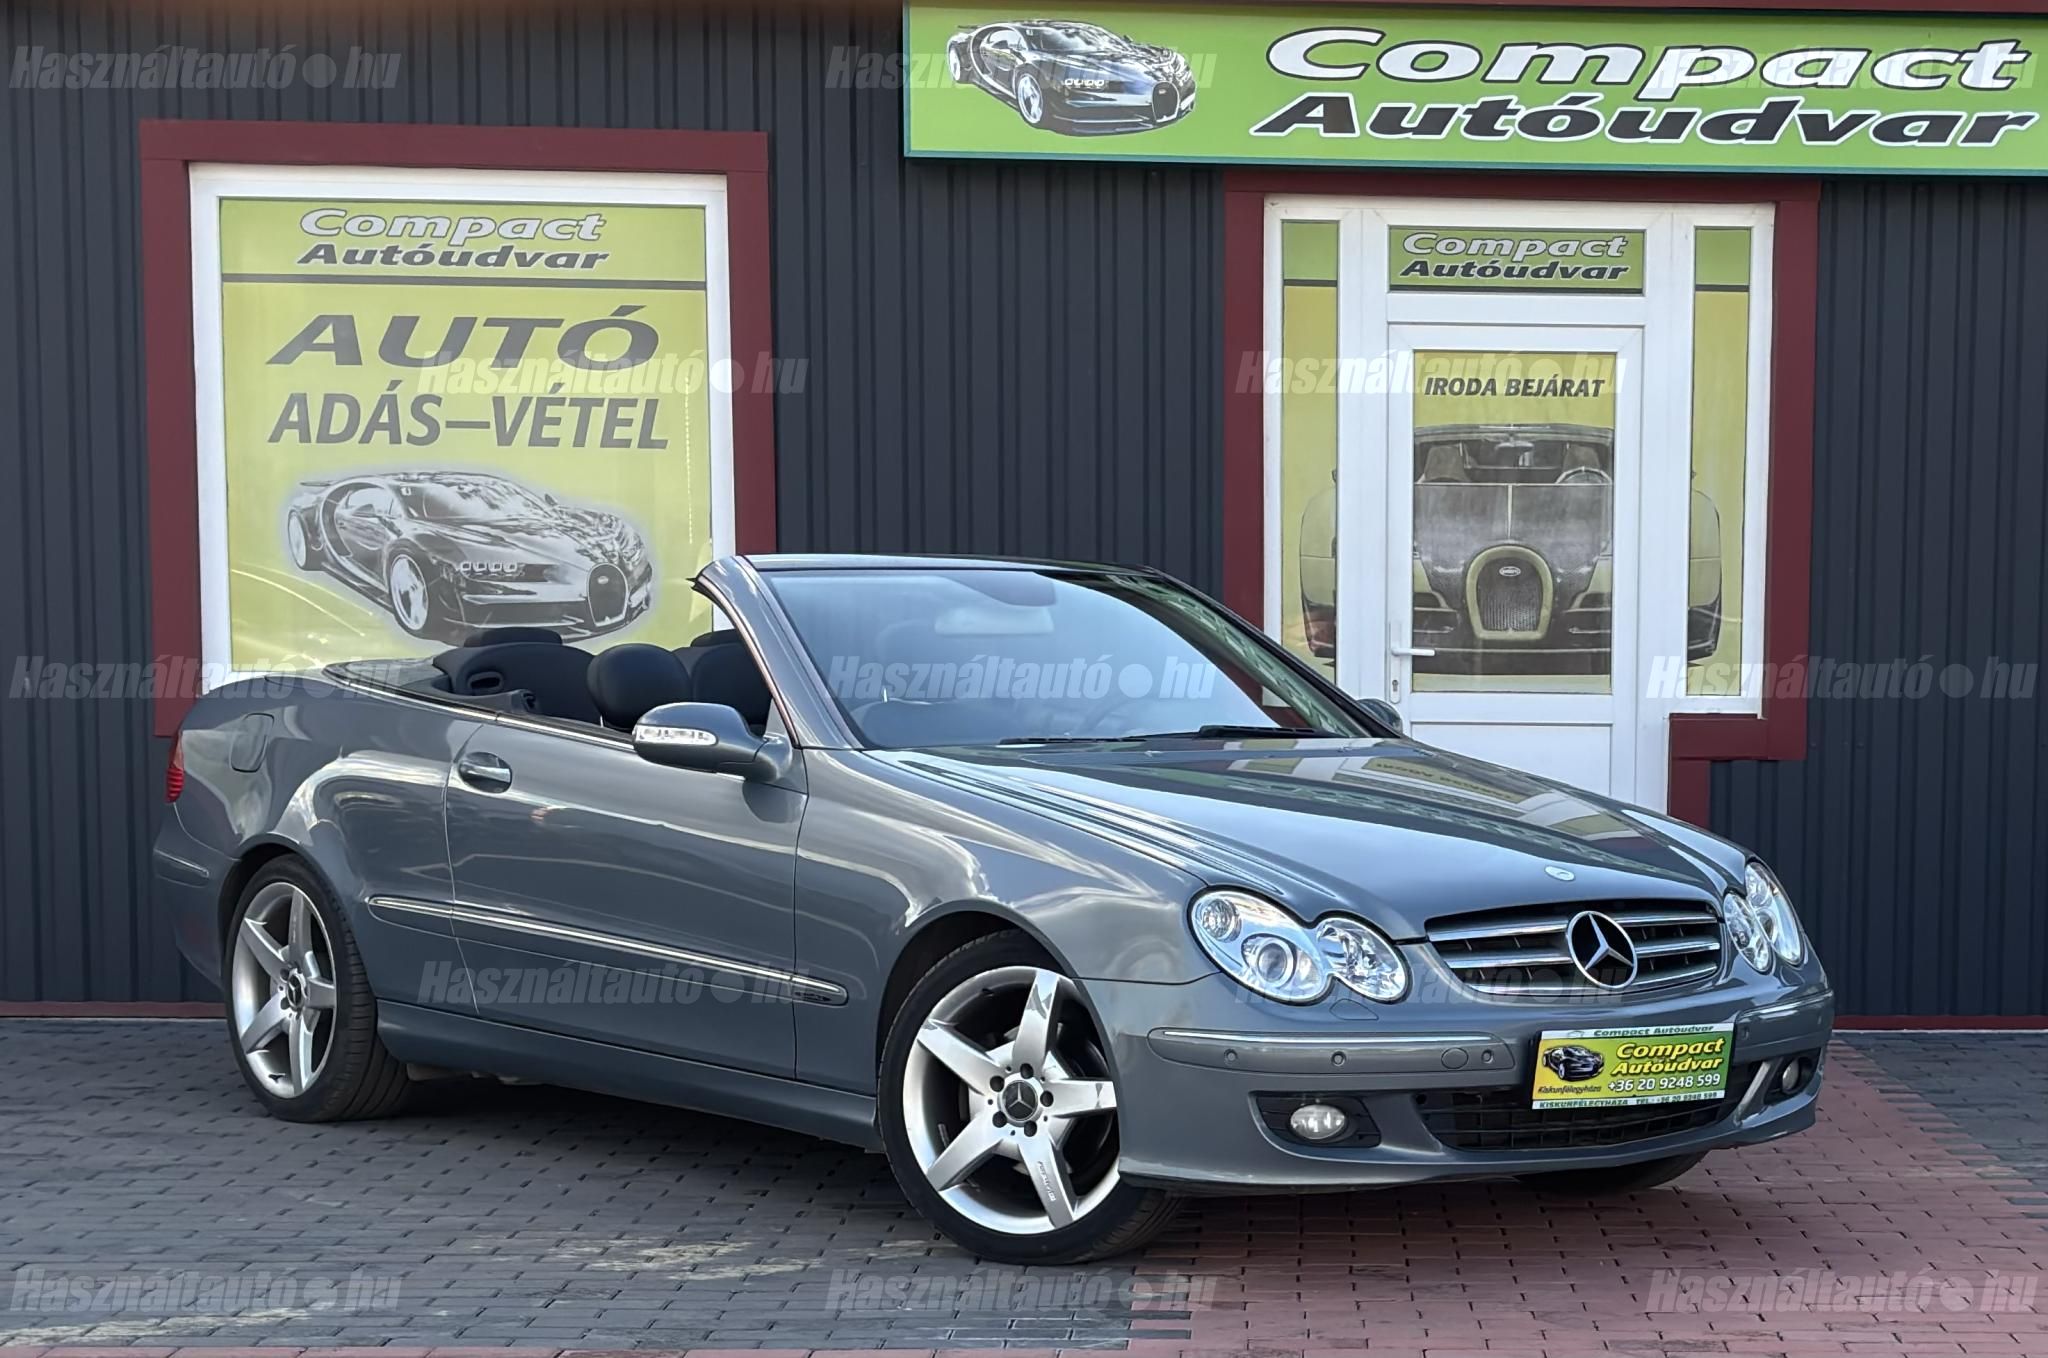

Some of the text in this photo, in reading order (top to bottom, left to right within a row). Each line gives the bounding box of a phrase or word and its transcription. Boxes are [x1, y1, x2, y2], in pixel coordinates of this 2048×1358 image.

[1266, 26, 2031, 101] Compact
[1249, 92, 2040, 147] Autóudvar
[300, 208, 606, 247] Compact
[297, 243, 608, 270] Autóudvar
[1403, 232, 1628, 262] Compact
[1399, 260, 1629, 280] Autóudvar
[266, 305, 660, 371] AUTÓ
[1424, 374, 1605, 397] IRODA BEJÁRAT
[1594, 1028, 1650, 1038] Compact
[1616, 1037, 1725, 1060] Compact
[1607, 1073, 1721, 1093] +36 20 9248 599
